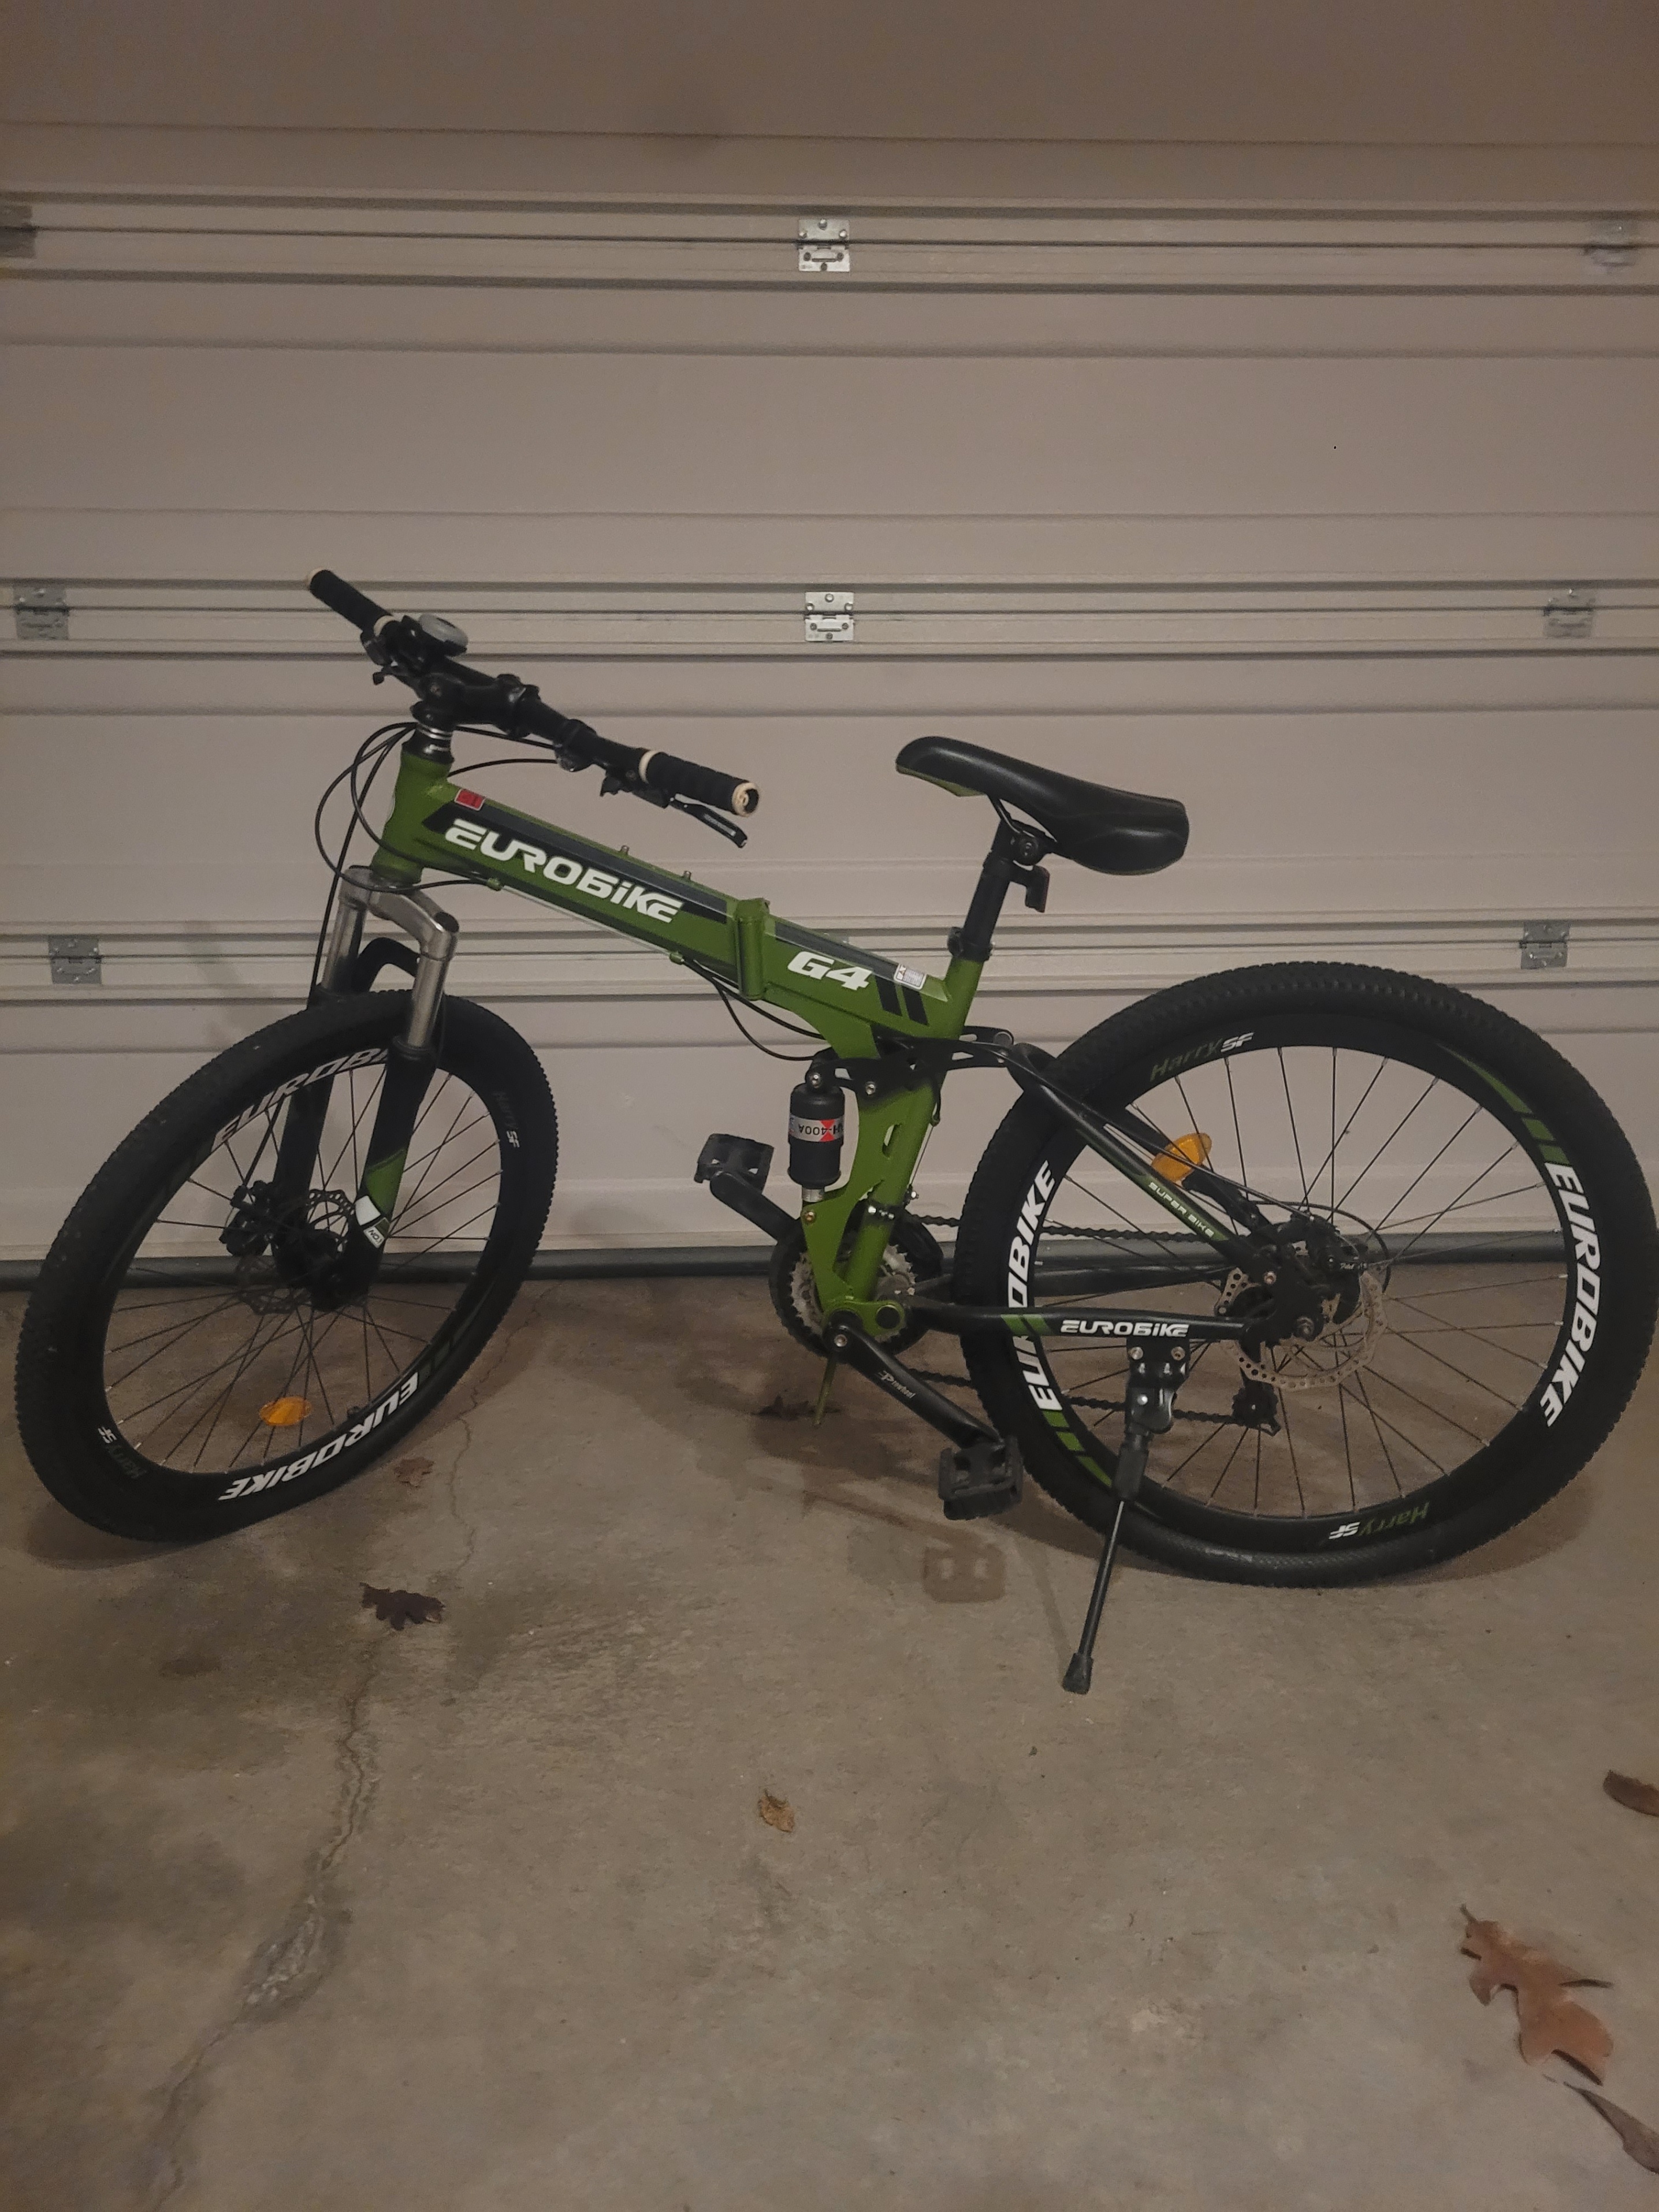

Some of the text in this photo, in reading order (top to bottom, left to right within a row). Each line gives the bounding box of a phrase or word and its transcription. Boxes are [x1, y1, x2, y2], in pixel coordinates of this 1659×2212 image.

[787, 951, 873, 990] G4
[1220, 1032, 1254, 1052] SF
[1148, 1182, 1215, 1238] SUPER BIKE
[1539, 1162, 1601, 1427] EUROBIKE
[218, 1372, 419, 1500] EUROBIKE
[1328, 1521, 1361, 1540] SF
